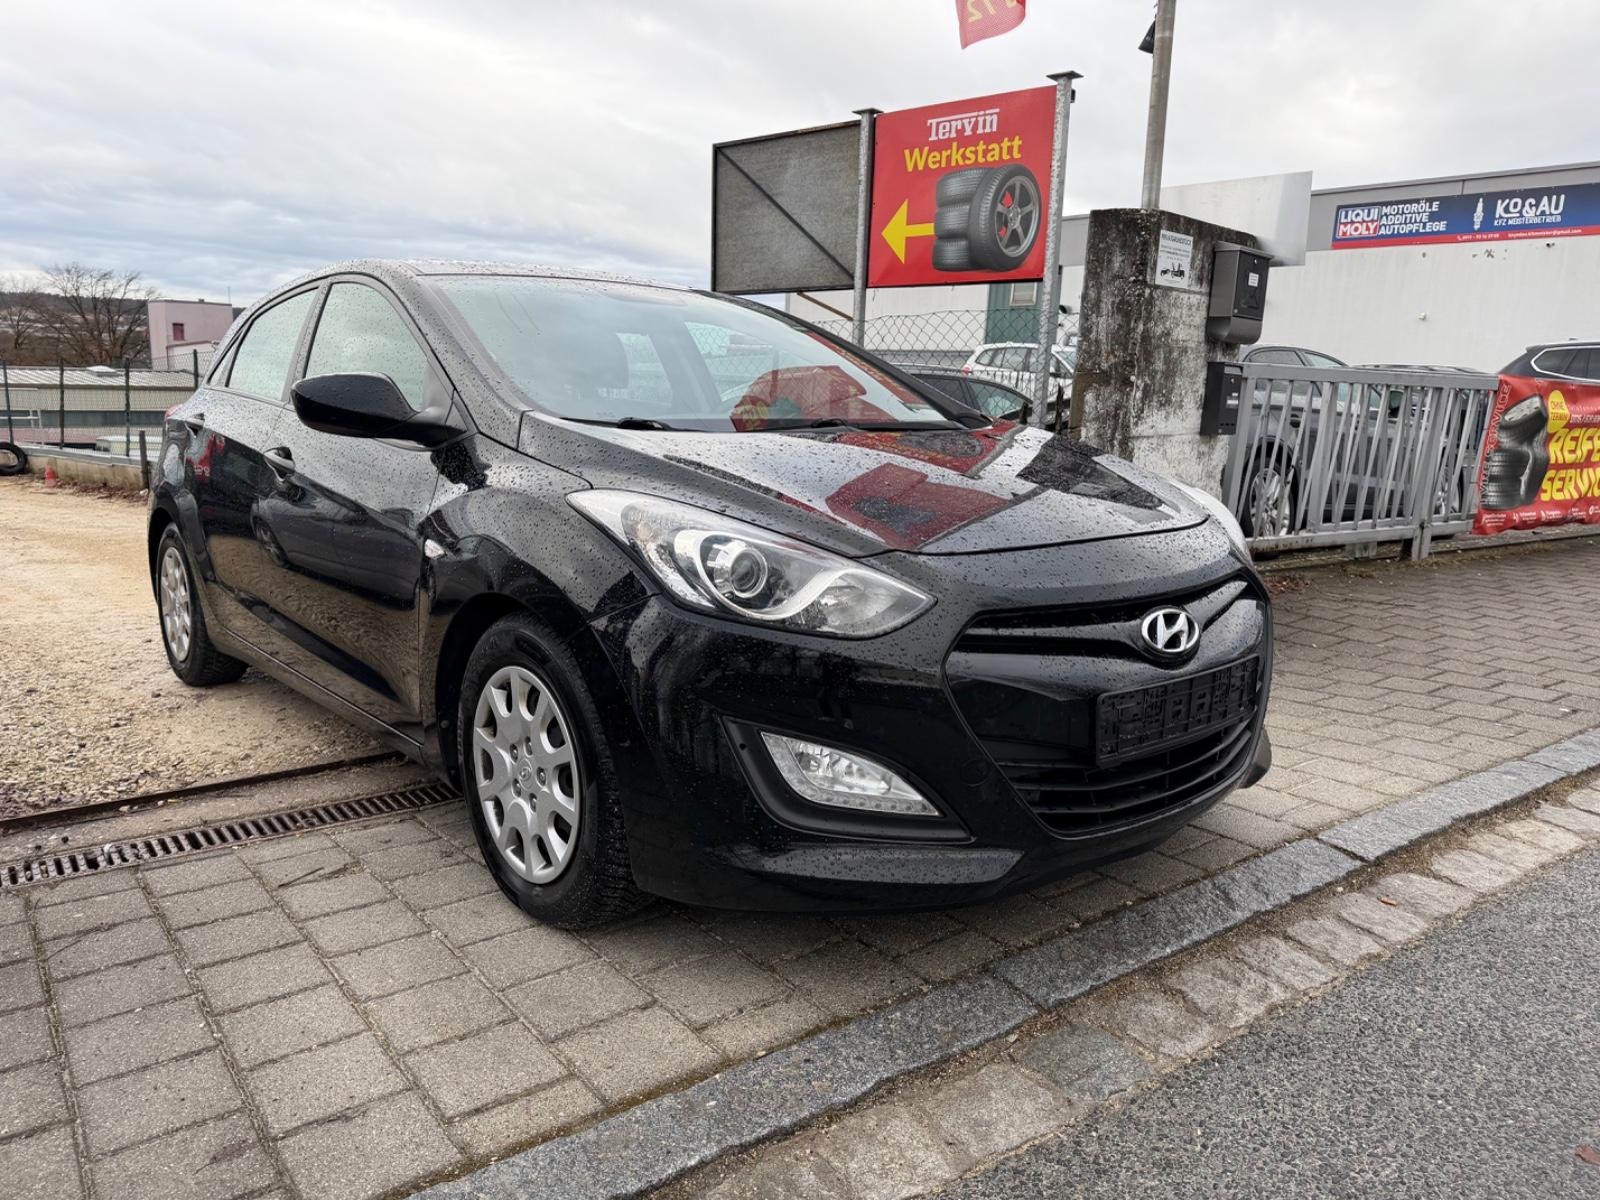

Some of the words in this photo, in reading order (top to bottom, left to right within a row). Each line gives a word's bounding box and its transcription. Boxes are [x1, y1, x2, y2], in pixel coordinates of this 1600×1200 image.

[927, 108, 1000, 141] Tervin
[903, 135, 1022, 172] Werkstatt
[1381, 200, 1440, 215] MOTORÖLE
[1340, 208, 1379, 222] LIQUI
[1379, 212, 1430, 225] ADDITIVE
[1338, 222, 1378, 236] MOLY
[1379, 221, 1448, 235] AUTOPFLEGE
